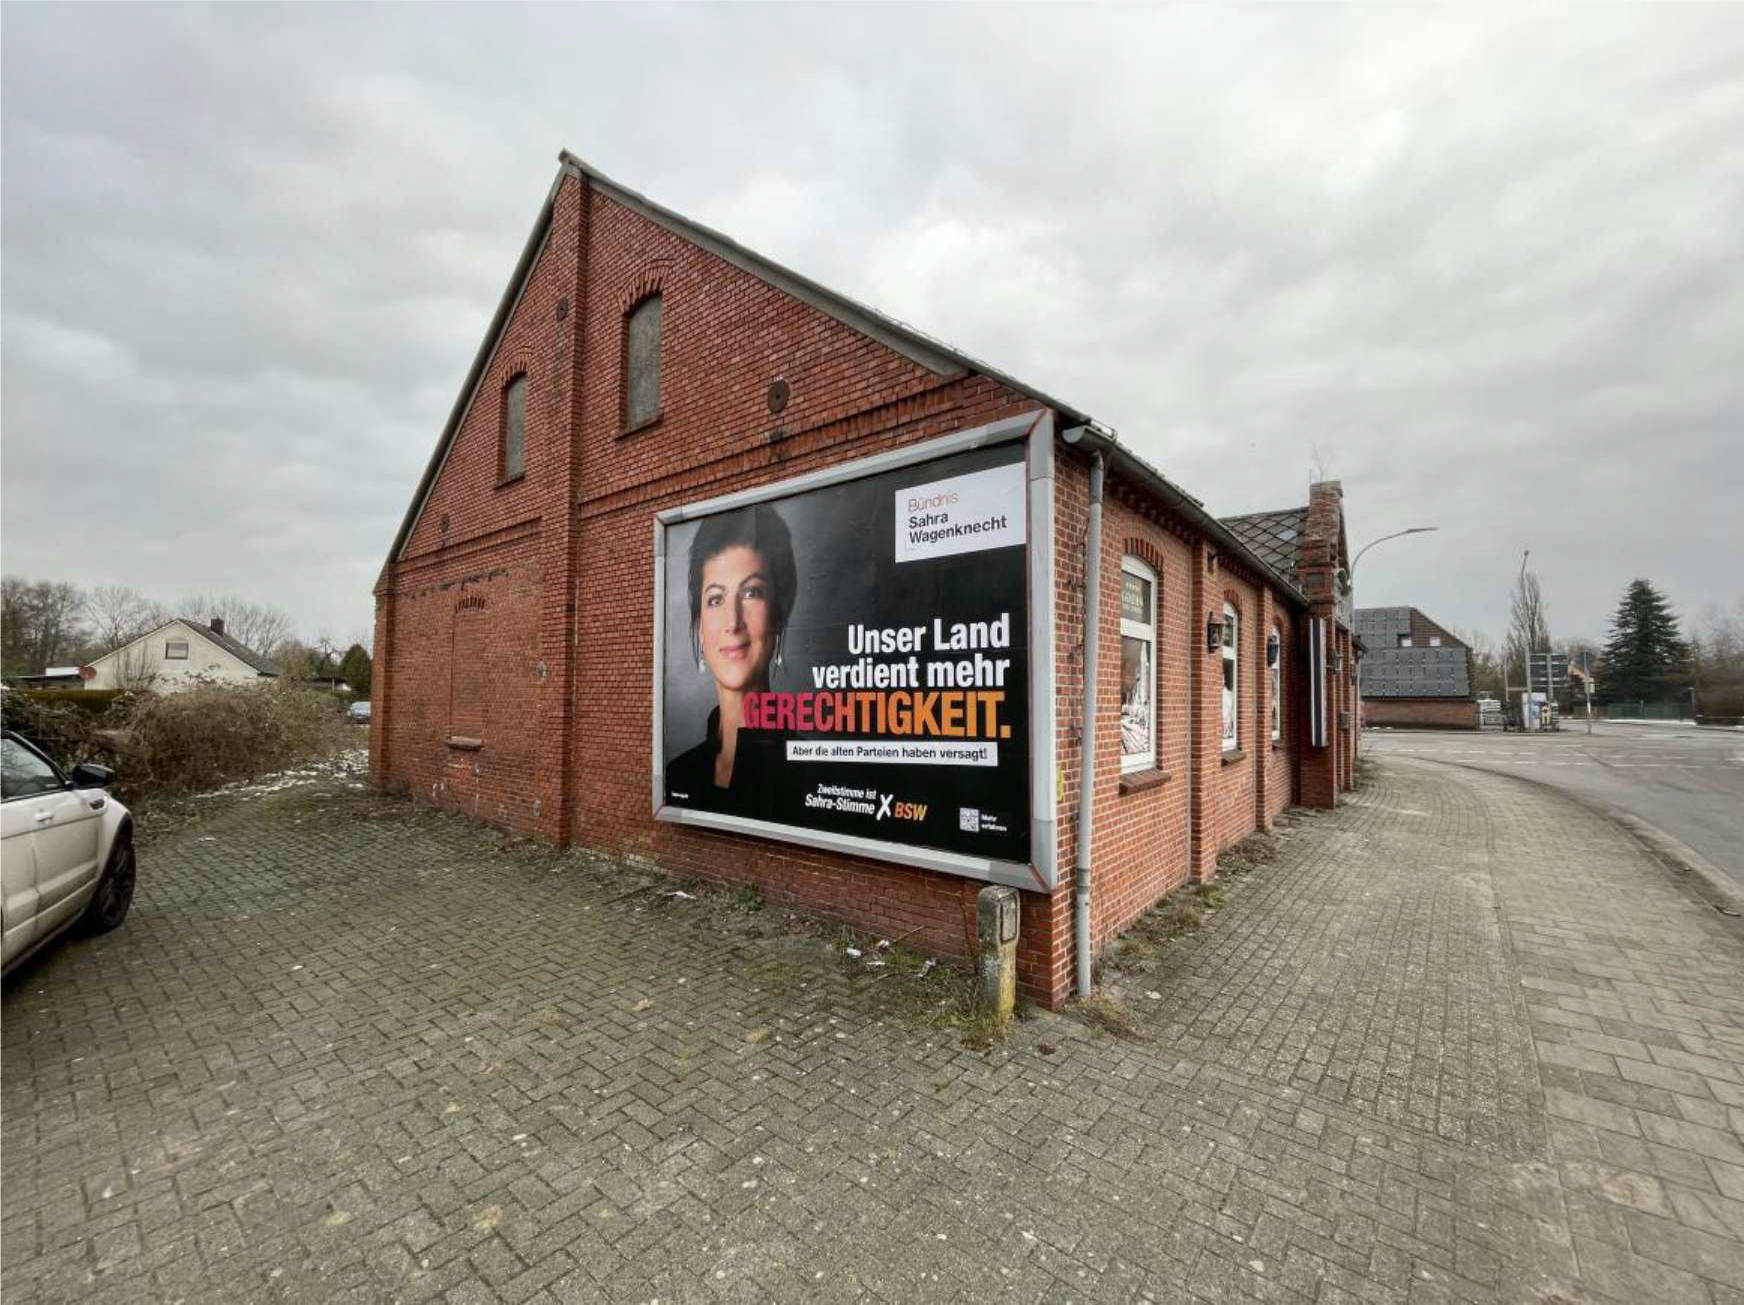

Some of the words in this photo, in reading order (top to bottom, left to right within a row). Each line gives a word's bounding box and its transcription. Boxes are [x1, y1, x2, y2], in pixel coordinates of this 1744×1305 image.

[908, 492, 960, 512] Bündnis
[909, 513, 949, 529] Sahra
[910, 515, 1007, 544] Wagenknecht
[848, 624, 926, 654] Unser
[934, 613, 1010, 651] Land
[813, 656, 919, 689] verdient
[927, 653, 1010, 687] mehr
[743, 691, 1011, 739] GERECHTIGKEIT.
[792, 745, 813, 756] Aber
[815, 746, 829, 756] die
[831, 746, 854, 757] alten
[857, 746, 899, 758] Parteien
[902, 747, 937, 758] haben
[940, 748, 987, 761] versagt!
[805, 793, 875, 815] Sahra-Stimme
[895, 801, 928, 821] BSW
